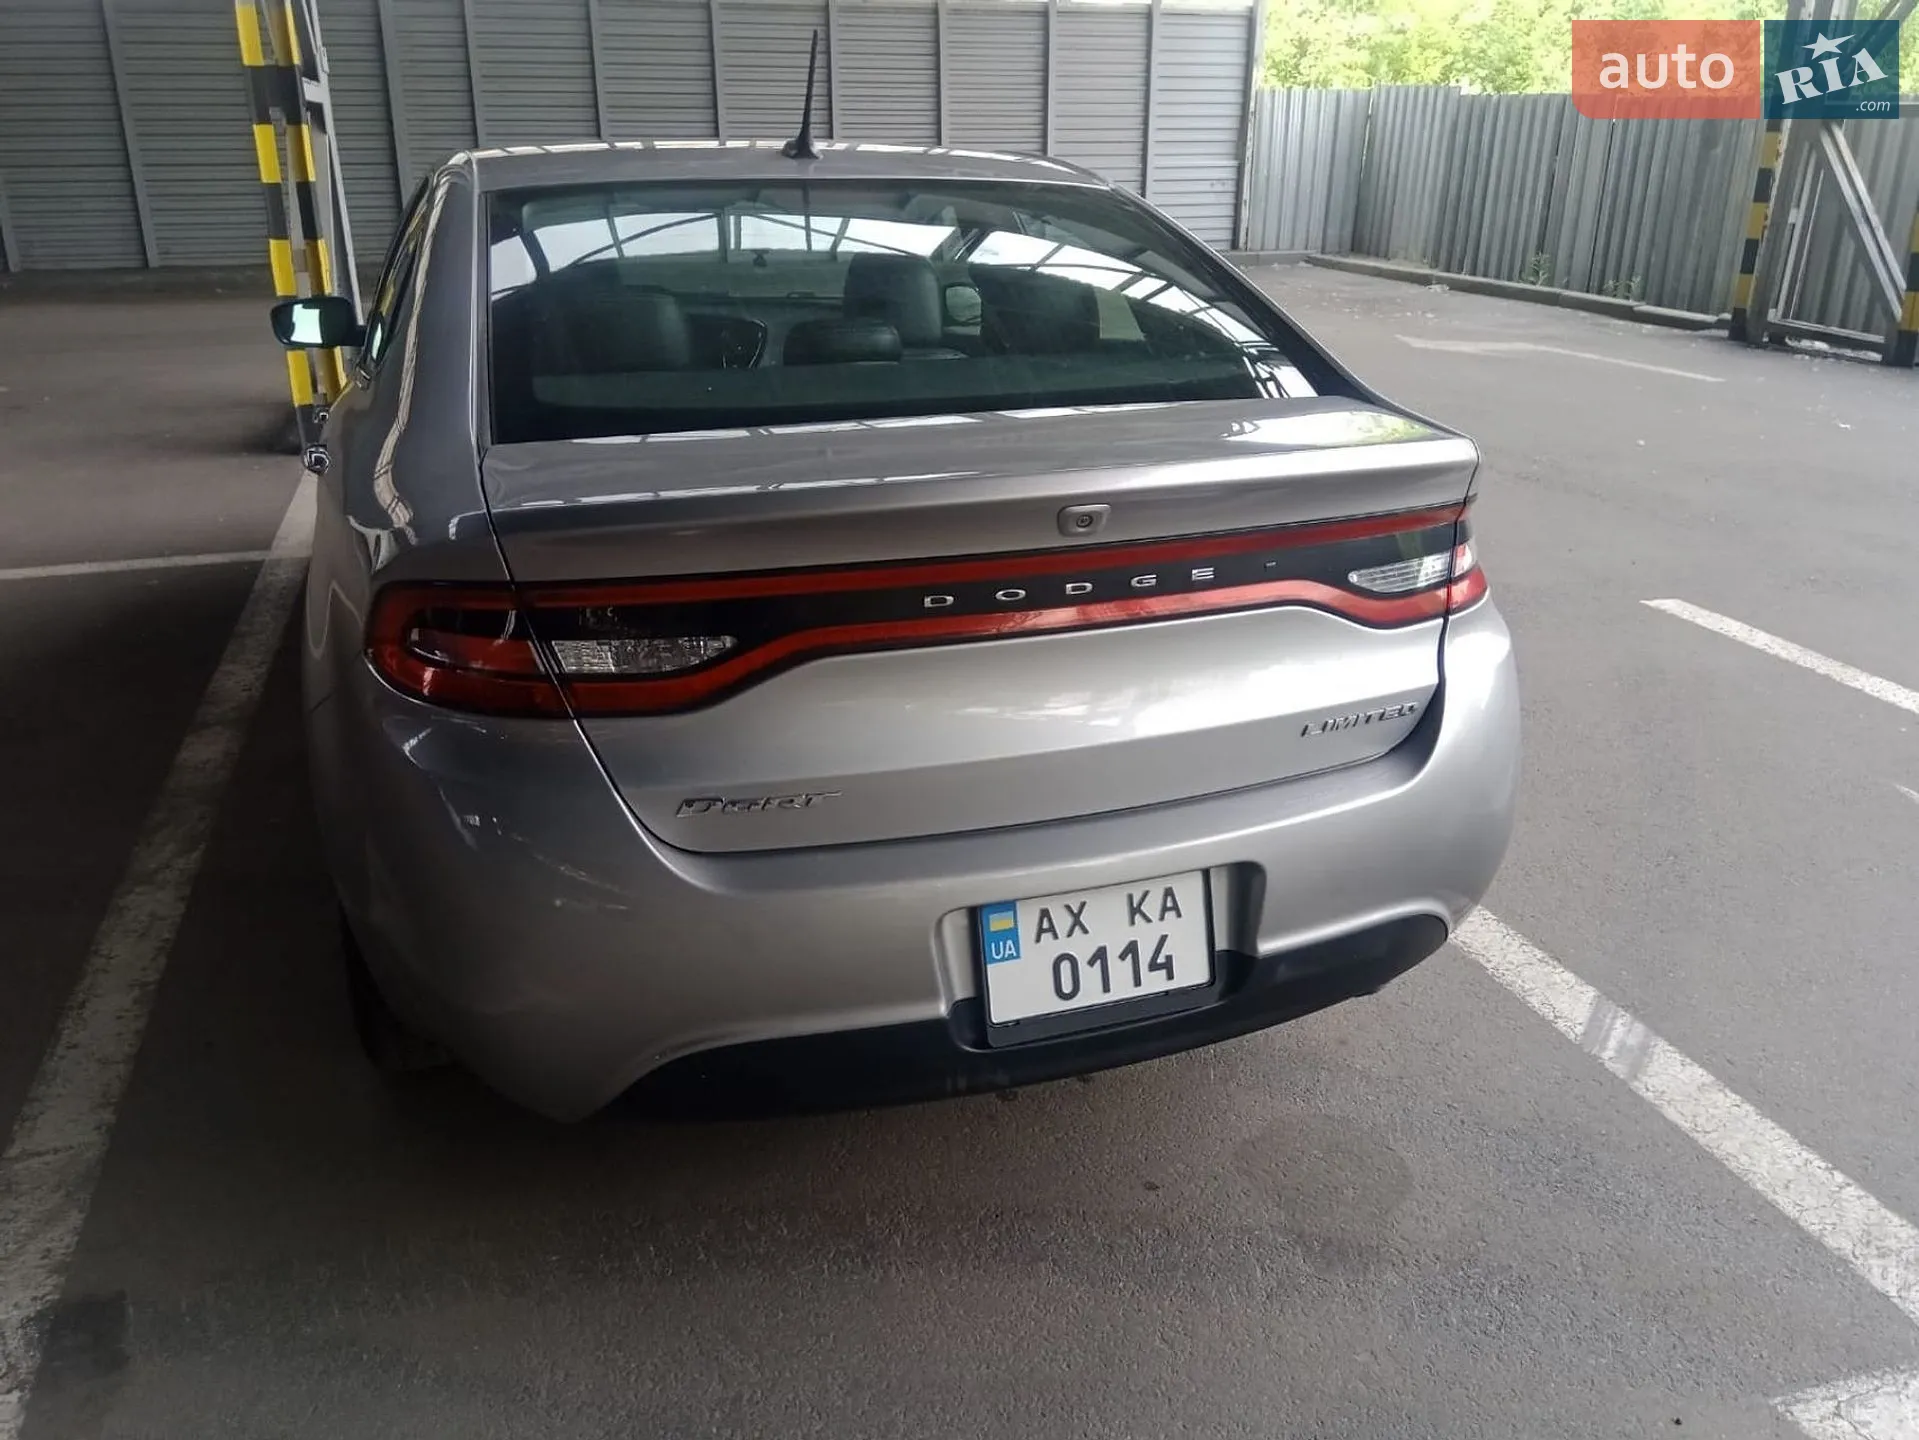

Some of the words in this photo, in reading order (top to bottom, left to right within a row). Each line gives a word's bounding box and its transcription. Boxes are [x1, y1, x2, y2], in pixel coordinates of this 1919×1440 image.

[924, 567, 1215, 608] DODGE
[1301, 701, 1418, 737] LIMITED
[1034, 900, 1090, 943] AX
[1126, 886, 1183, 926] KA
[990, 940, 1017, 960] UA
[1052, 934, 1175, 1001] 0114
